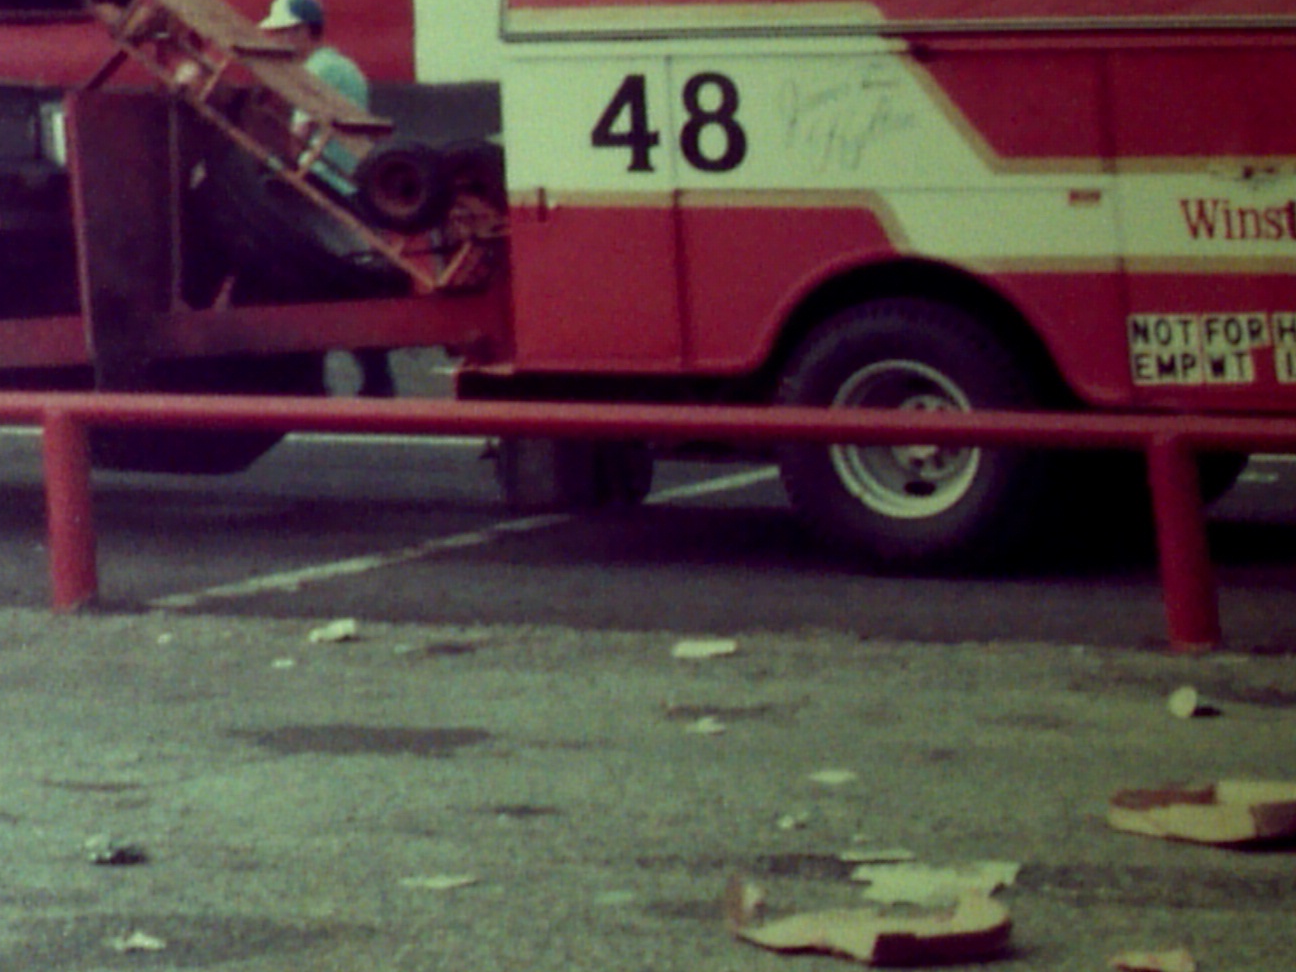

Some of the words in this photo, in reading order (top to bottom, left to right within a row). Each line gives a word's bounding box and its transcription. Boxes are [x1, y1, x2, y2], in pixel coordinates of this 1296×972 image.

[590, 70, 748, 174] 48
[1131, 318, 1192, 346] NOT
[1205, 317, 1263, 346] FOR
